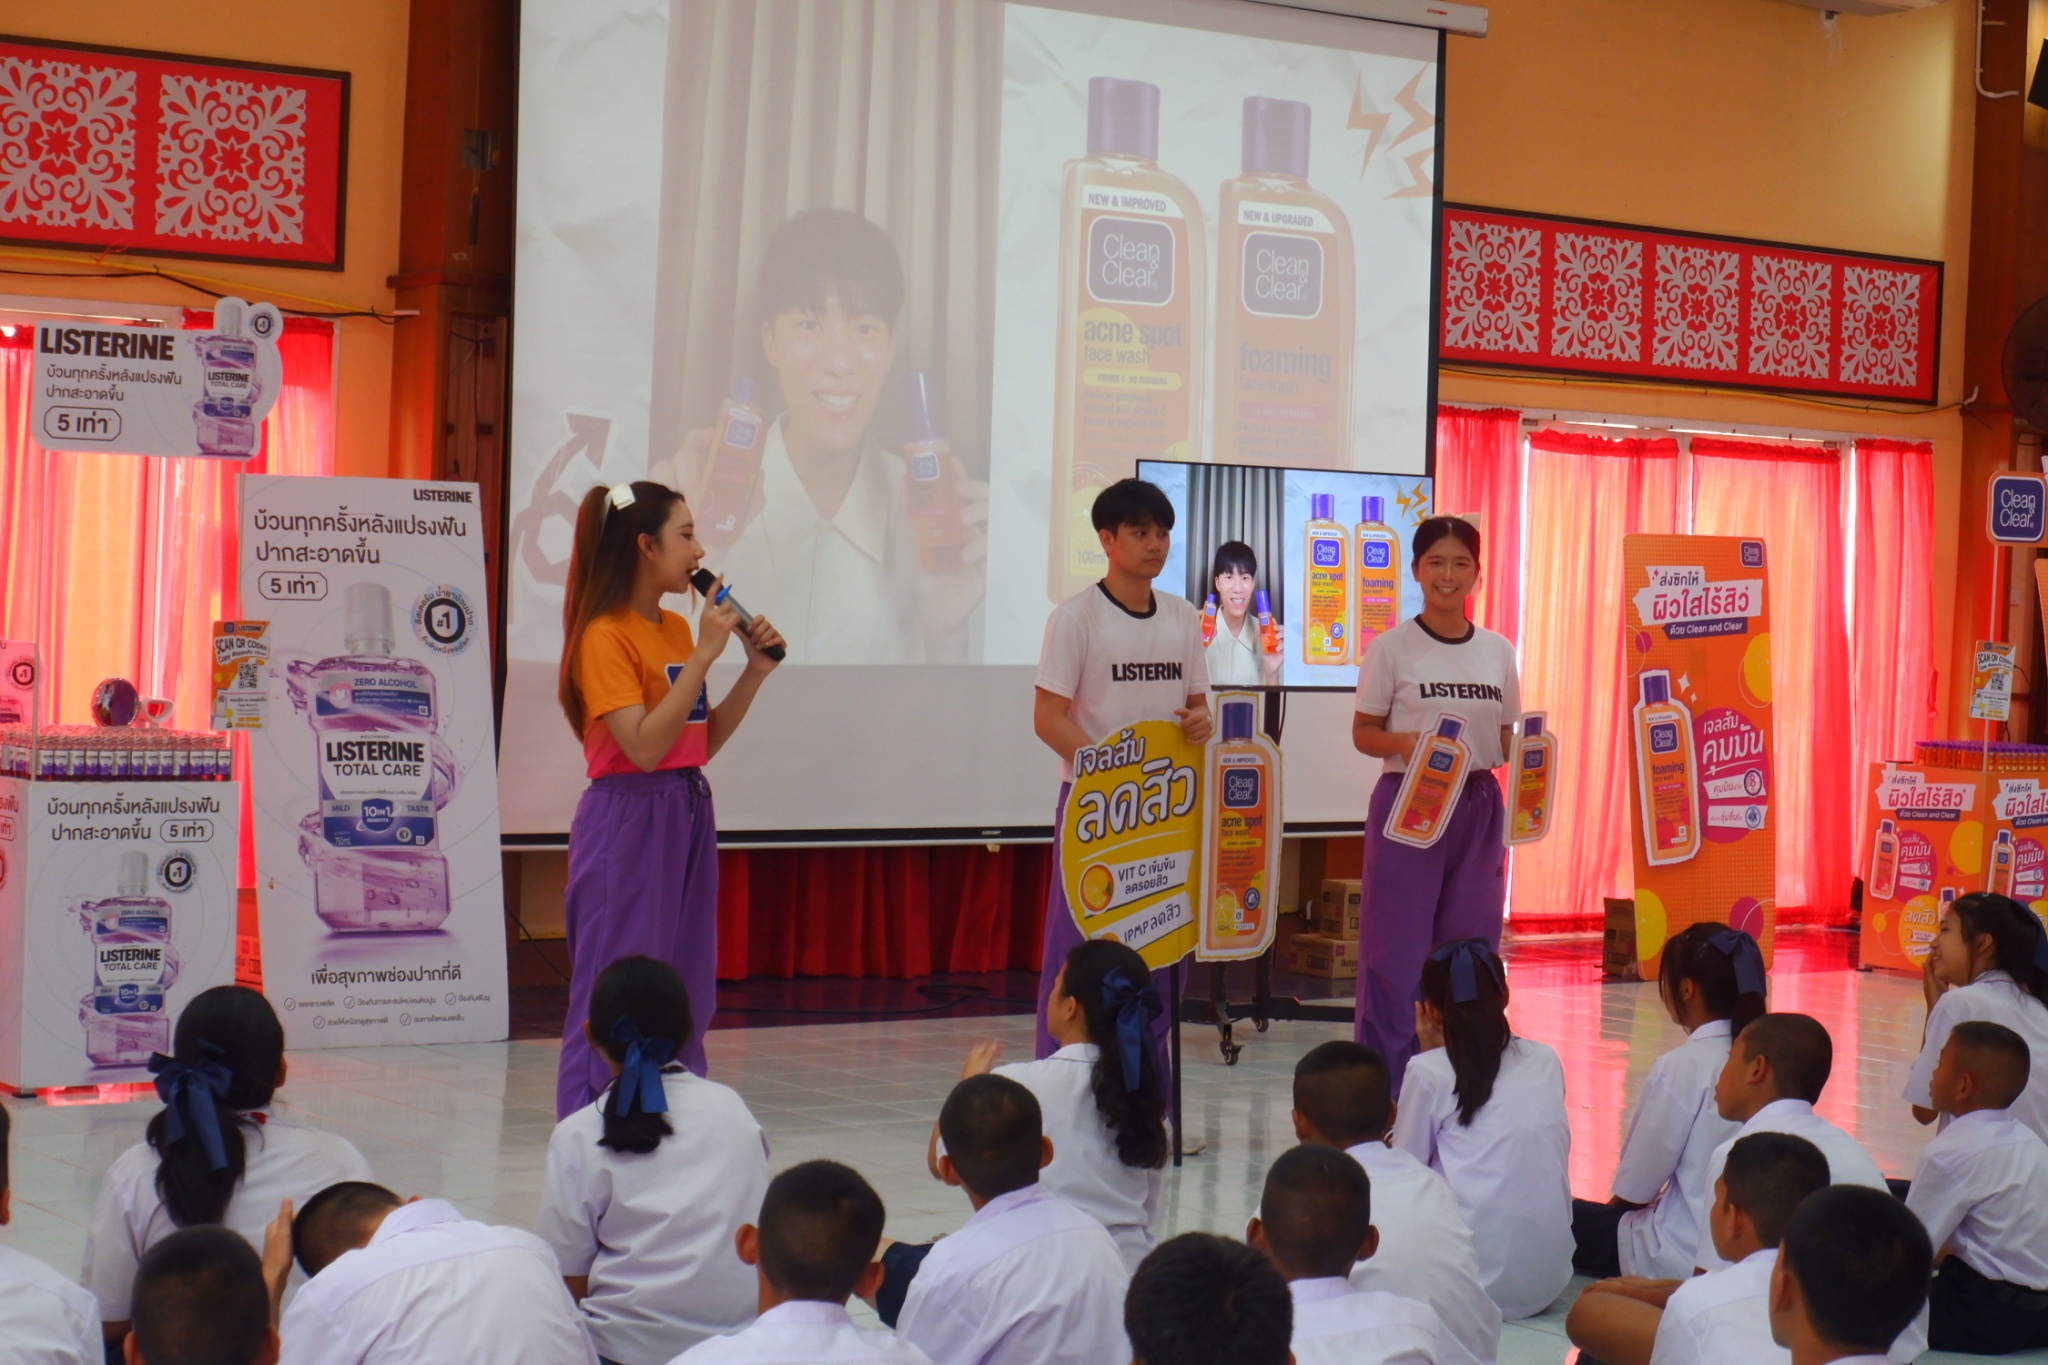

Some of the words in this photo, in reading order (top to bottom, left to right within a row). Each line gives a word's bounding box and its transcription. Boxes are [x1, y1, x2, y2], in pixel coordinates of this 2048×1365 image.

[1088, 193, 1109, 206] NEW
[1111, 195, 1119, 206] &
[1121, 196, 1167, 212] IMPROVED
[1243, 210, 1261, 222] NEW
[1263, 211, 1270, 223] &
[1271, 212, 1314, 228] UPGRADED
[1103, 234, 1160, 263] Clean
[1256, 248, 1309, 276] Clean
[1102, 260, 1153, 287] Clear
[1255, 275, 1303, 301] Clear
[1084, 318, 1133, 344] acne
[1139, 320, 1183, 350] spot
[40, 327, 175, 362] LISTERINE
[1084, 343, 1112, 362] face
[1116, 345, 1151, 365] wash
[1239, 341, 1332, 385] foaming
[47, 363, 182, 386] บ้วนทุกครั้งหลังแปรงฟัน
[208, 371, 250, 383] LISTERINE
[46, 384, 124, 402] ปากสะอาดขึ้น
[210, 381, 229, 389] TOTAL
[57, 414, 70, 432] 5
[413, 488, 473, 504] LISTERINE
[2001, 488, 2036, 508] Clean
[254, 505, 467, 538] บ้วนทุกครั้งหลังแปรงฟัน
[2000, 509, 2033, 528] Clear
[256, 537, 381, 564] ปากสะอาดขึ้น
[270, 578, 282, 594] 5
[1312, 572, 1328, 580] acne
[1329, 572, 1343, 582] spot
[1362, 577, 1394, 590] foaming
[1659, 571, 1700, 587] ส่งซิกให้
[1653, 586, 1750, 621] ผิวใสไร้สิว
[436, 611, 451, 629] #1
[1670, 624, 1686, 636] ด้วย
[1686, 624, 1708, 635] Clean
[1708, 623, 1723, 633] and
[1723, 621, 1743, 631] Clear
[215, 638, 234, 654] SCAN
[236, 638, 246, 648] QR
[354, 678, 377, 687] ZERO
[378, 679, 418, 689] ALCOHOL
[1703, 711, 1739, 735] เจลส้ม
[326, 741, 425, 763] LISTERINE
[1075, 729, 1146, 779] เจลส้ม
[1702, 724, 1764, 776] คุมมัน
[333, 763, 379, 776] TOTAL
[382, 764, 422, 777] CARE
[1652, 762, 1685, 776] foaming
[1228, 774, 1254, 790] Clean
[1749, 774, 1756, 787] 8
[1076, 757, 1198, 844] ลดสิว
[1228, 787, 1251, 801] Clear
[1888, 786, 1963, 807] ผิวใสไร้สิว
[47, 792, 220, 819] บ้วนทุกครั้งหลังแปรงฟัน
[406, 805, 430, 813] TASTE
[1911, 810, 1928, 819] Clean
[52, 818, 151, 841] ปากสะอาดขึ้น
[169, 825, 179, 838] 5
[1221, 815, 1243, 828] acne
[1244, 814, 1263, 830] spot
[1118, 866, 1136, 882] VIT
[1138, 864, 1147, 877] C
[1148, 857, 1176, 875] เข้มข้น
[1125, 874, 1169, 895] ลดรอยสิว
[100, 949, 162, 964] LISTERINE
[104, 963, 131, 971] TOTAL
[134, 962, 158, 971] CARE
[311, 961, 462, 989] เพื่อสุขภาพช่องปากที่ดี
